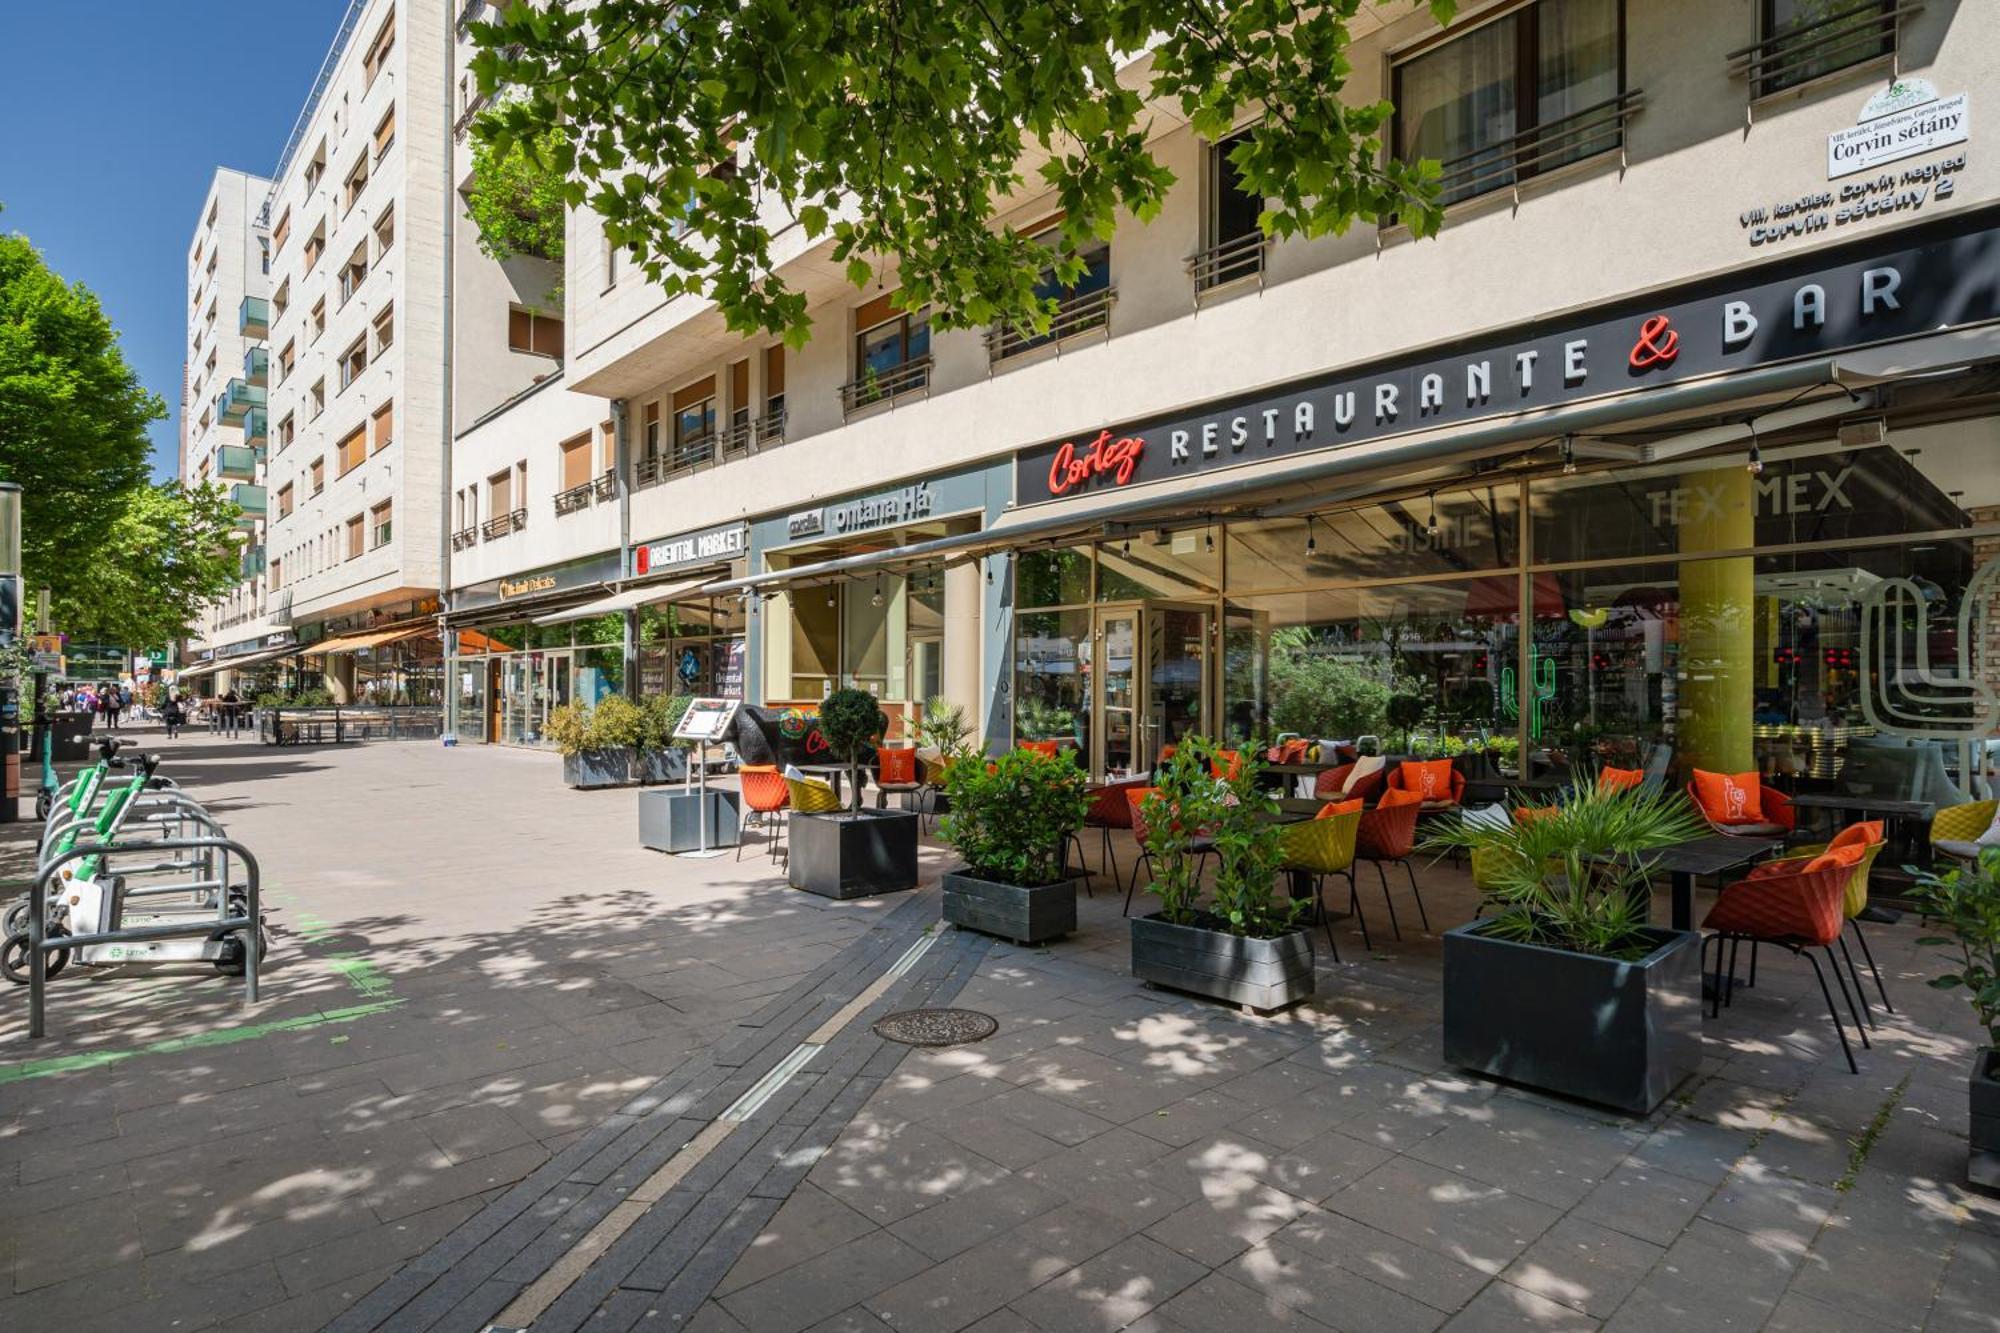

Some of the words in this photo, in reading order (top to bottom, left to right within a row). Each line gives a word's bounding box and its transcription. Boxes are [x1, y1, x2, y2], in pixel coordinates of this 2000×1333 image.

[1834, 132, 1892, 160] Corvin
[1898, 112, 1963, 143] sétány
[1840, 175, 1896, 198] Corvin
[1900, 152, 1966, 182] negyed
[1750, 212, 1828, 245] Corvin
[1836, 187, 1929, 222] sétány
[1934, 176, 1954, 201] 2
[1049, 429, 1145, 494] Cortez
[1171, 339, 1587, 460] RESTAURANTE
[1629, 315, 1680, 367] &
[1724, 266, 1902, 343] BAR
[650, 538, 698, 568] ORIENTAL
[698, 527, 745, 558] MARKET
